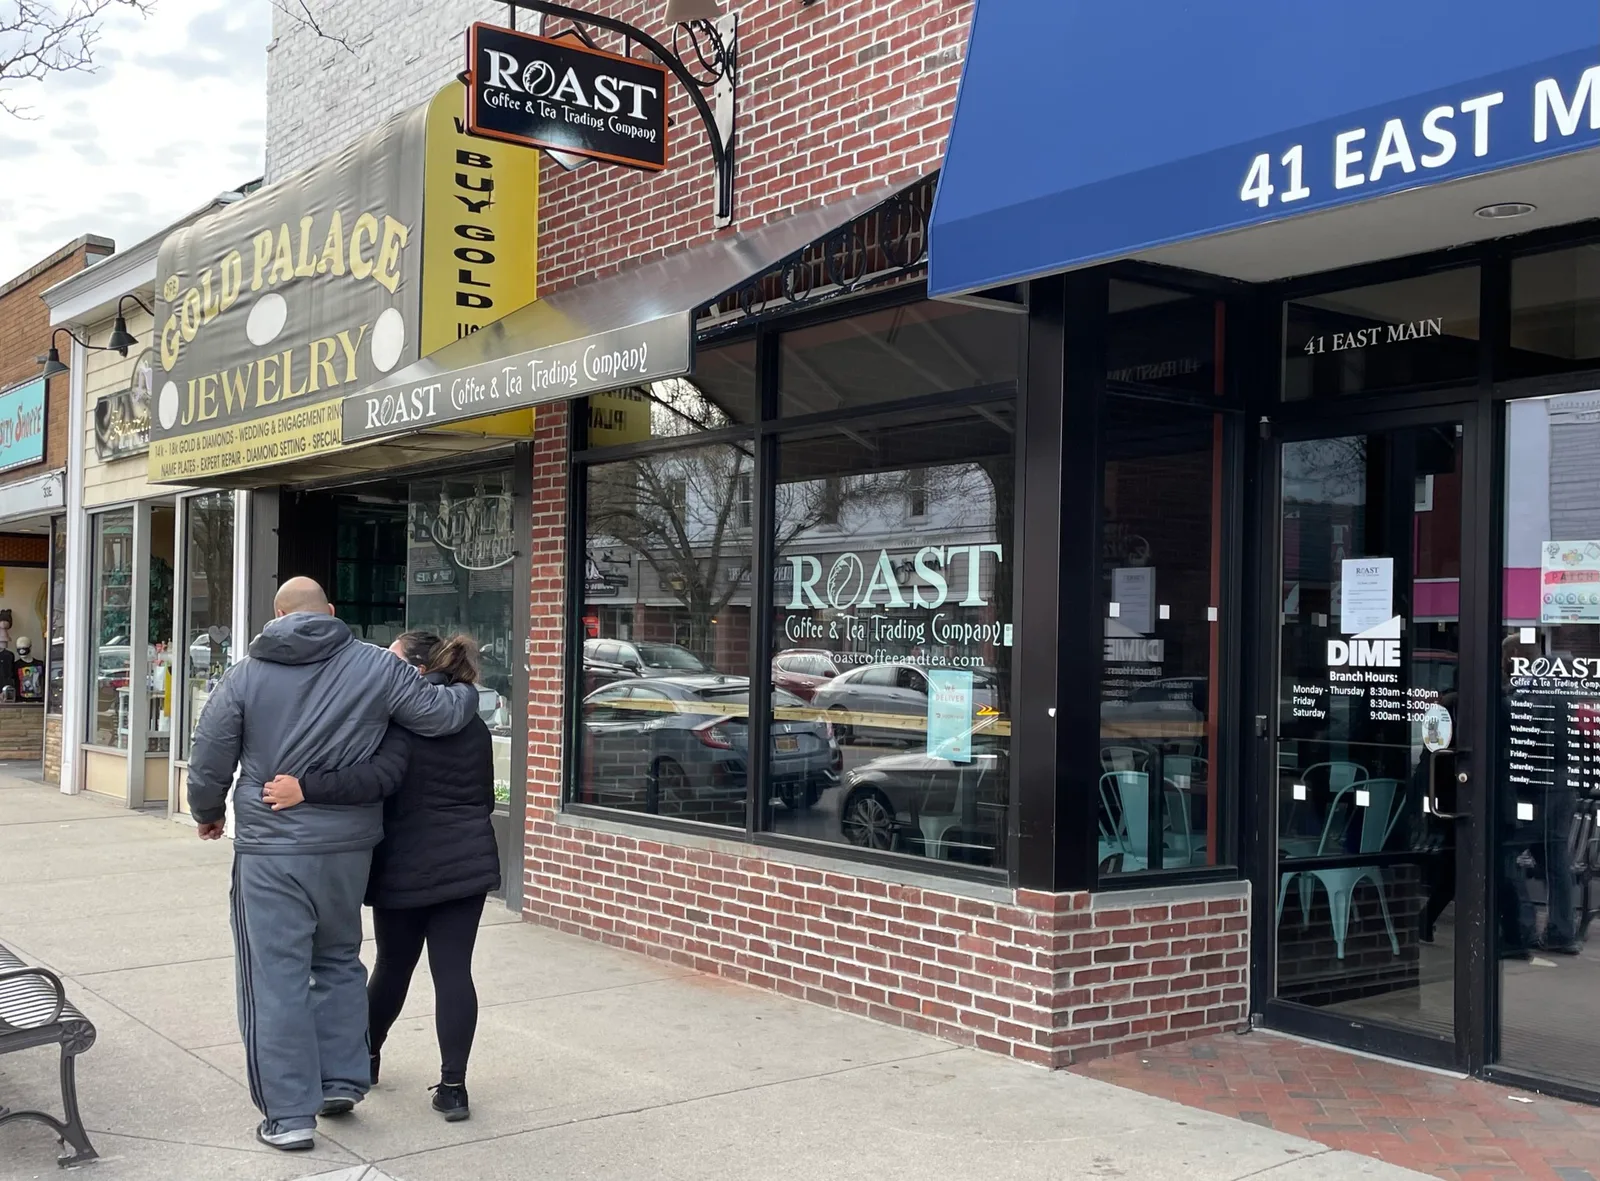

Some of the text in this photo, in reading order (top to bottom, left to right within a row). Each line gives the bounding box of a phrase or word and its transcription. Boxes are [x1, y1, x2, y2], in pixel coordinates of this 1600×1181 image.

[483, 48, 658, 121] ROAST
[483, 88, 657, 144] Coffee & Tea Trading Company
[1240, 144, 1310, 208] 41
[1334, 91, 1504, 190] EAST
[160, 210, 408, 373] GOLD PALACE
[1302, 316, 1444, 356] 41 EAST MAIN
[180, 324, 369, 427] JEWELRY
[364, 341, 649, 430] ROAST Coffee & Tea Trading Company
[179, 439, 196, 454] GOLD
[202, 431, 234, 449] DIAMONDS
[239, 424, 270, 441] WEDDING
[271, 422, 277, 435] &
[278, 409, 325, 432] ENGAGEMENT
[161, 461, 177, 477] NAME
[177, 458, 196, 474] PLATES
[200, 454, 221, 471] EXPERT
[221, 451, 241, 467] REPAIR
[246, 444, 278, 463] DIAMOND
[279, 438, 306, 454] SETTING
[785, 543, 1003, 610] ROAST
[785, 615, 823, 643] Coffee
[829, 622, 839, 639] &
[842, 614, 865, 641] Tea
[871, 614, 925, 644] Trading
[931, 613, 1001, 646] Company
[1327, 640, 1401, 667] DIME
[1293, 685, 1324, 696] Monday
[1330, 686, 1365, 697] Thursday
[1370, 687, 1400, 697] 8:30am
[1406, 688, 1438, 700] 4:00pm
[1330, 671, 1398, 683] Branch Hours:
[1510, 676, 1531, 687] Coffee
[1532, 679, 1538, 687] &
[1539, 677, 1550, 687] Tea
[1553, 677, 1578, 689] Trading
[935, 692, 965, 704] DELIVER
[1293, 697, 1315, 707] Friday
[1370, 699, 1400, 709] 8:30am
[1407, 701, 1438, 712] 5:00pm
[1293, 708, 1326, 719] Saturday
[1370, 711, 1400, 721] 9:00am
